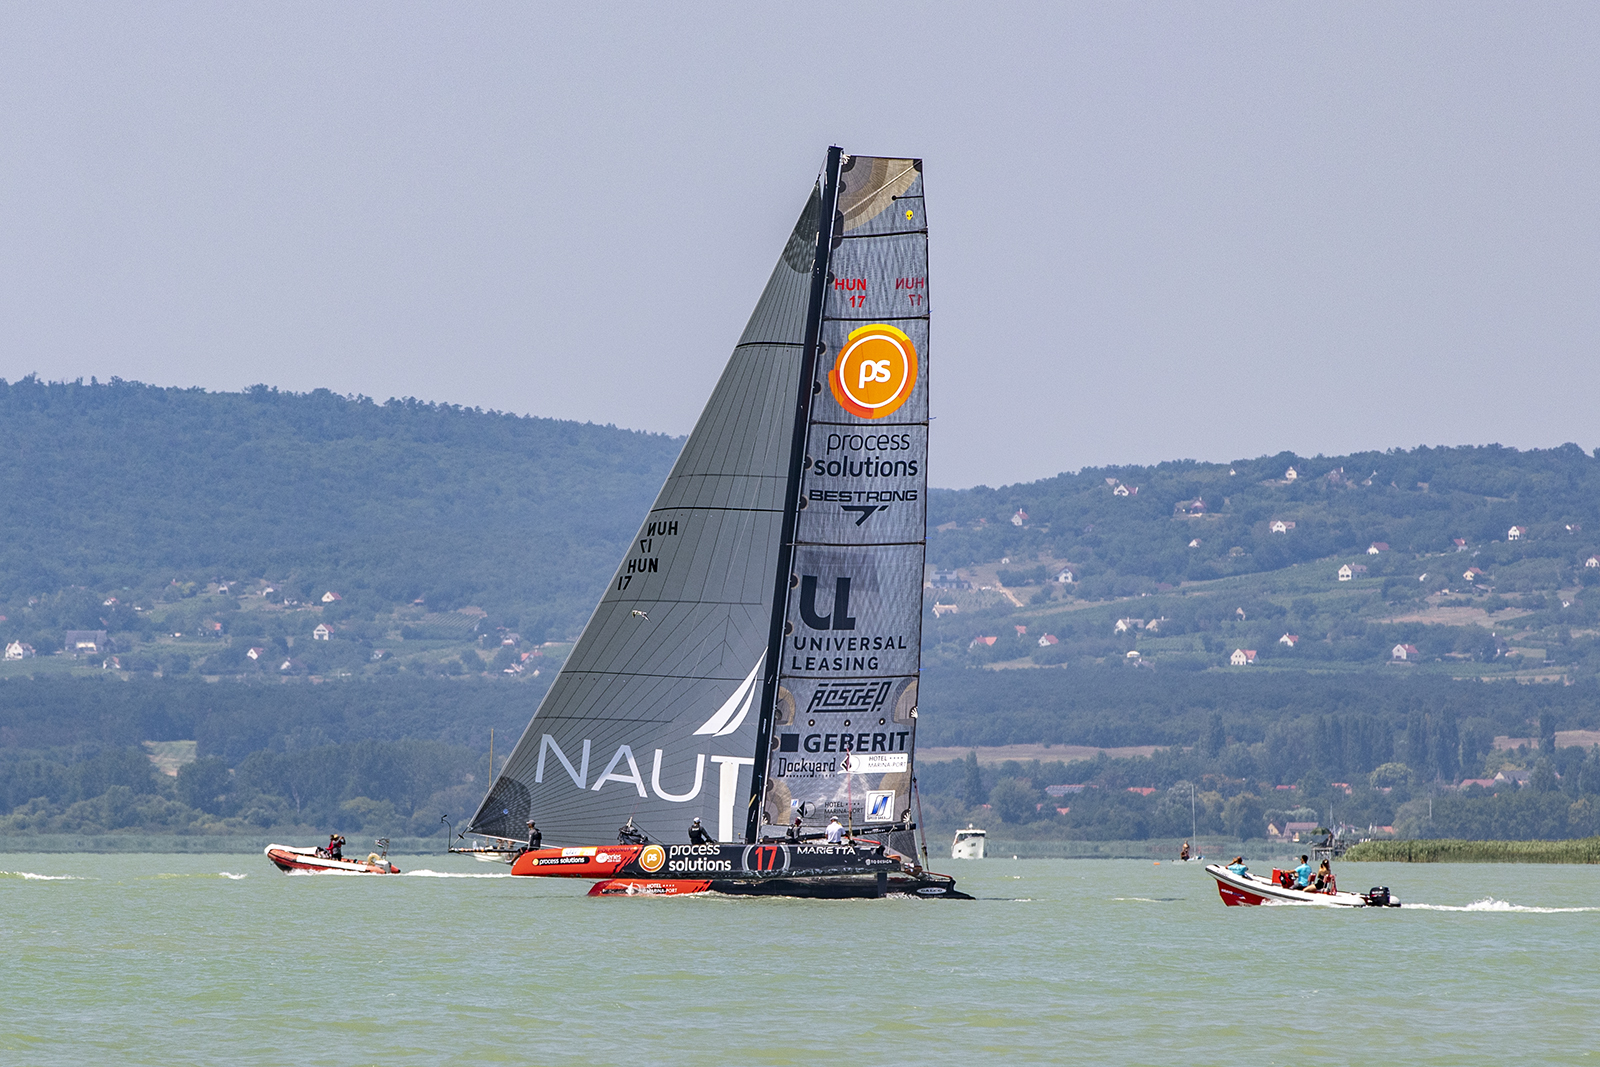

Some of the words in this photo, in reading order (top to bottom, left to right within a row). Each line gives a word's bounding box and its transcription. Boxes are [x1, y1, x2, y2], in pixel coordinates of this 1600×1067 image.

[834, 278, 867, 291] HUN
[849, 295, 866, 308] 17
[858, 359, 891, 389] ps
[826, 433, 910, 455] process
[814, 456, 918, 477] solutions
[809, 489, 918, 502] BESTRONG
[627, 557, 659, 574] HUN
[617, 575, 633, 591] 17
[793, 635, 907, 651] UNIVERSAL
[792, 656, 879, 671] LEASING
[803, 732, 910, 753] GEBERIT
[777, 757, 836, 778] Dockyard
[669, 844, 720, 859] process
[754, 846, 778, 871] 17
[539, 858, 559, 866] process
[668, 857, 732, 872] solutions
